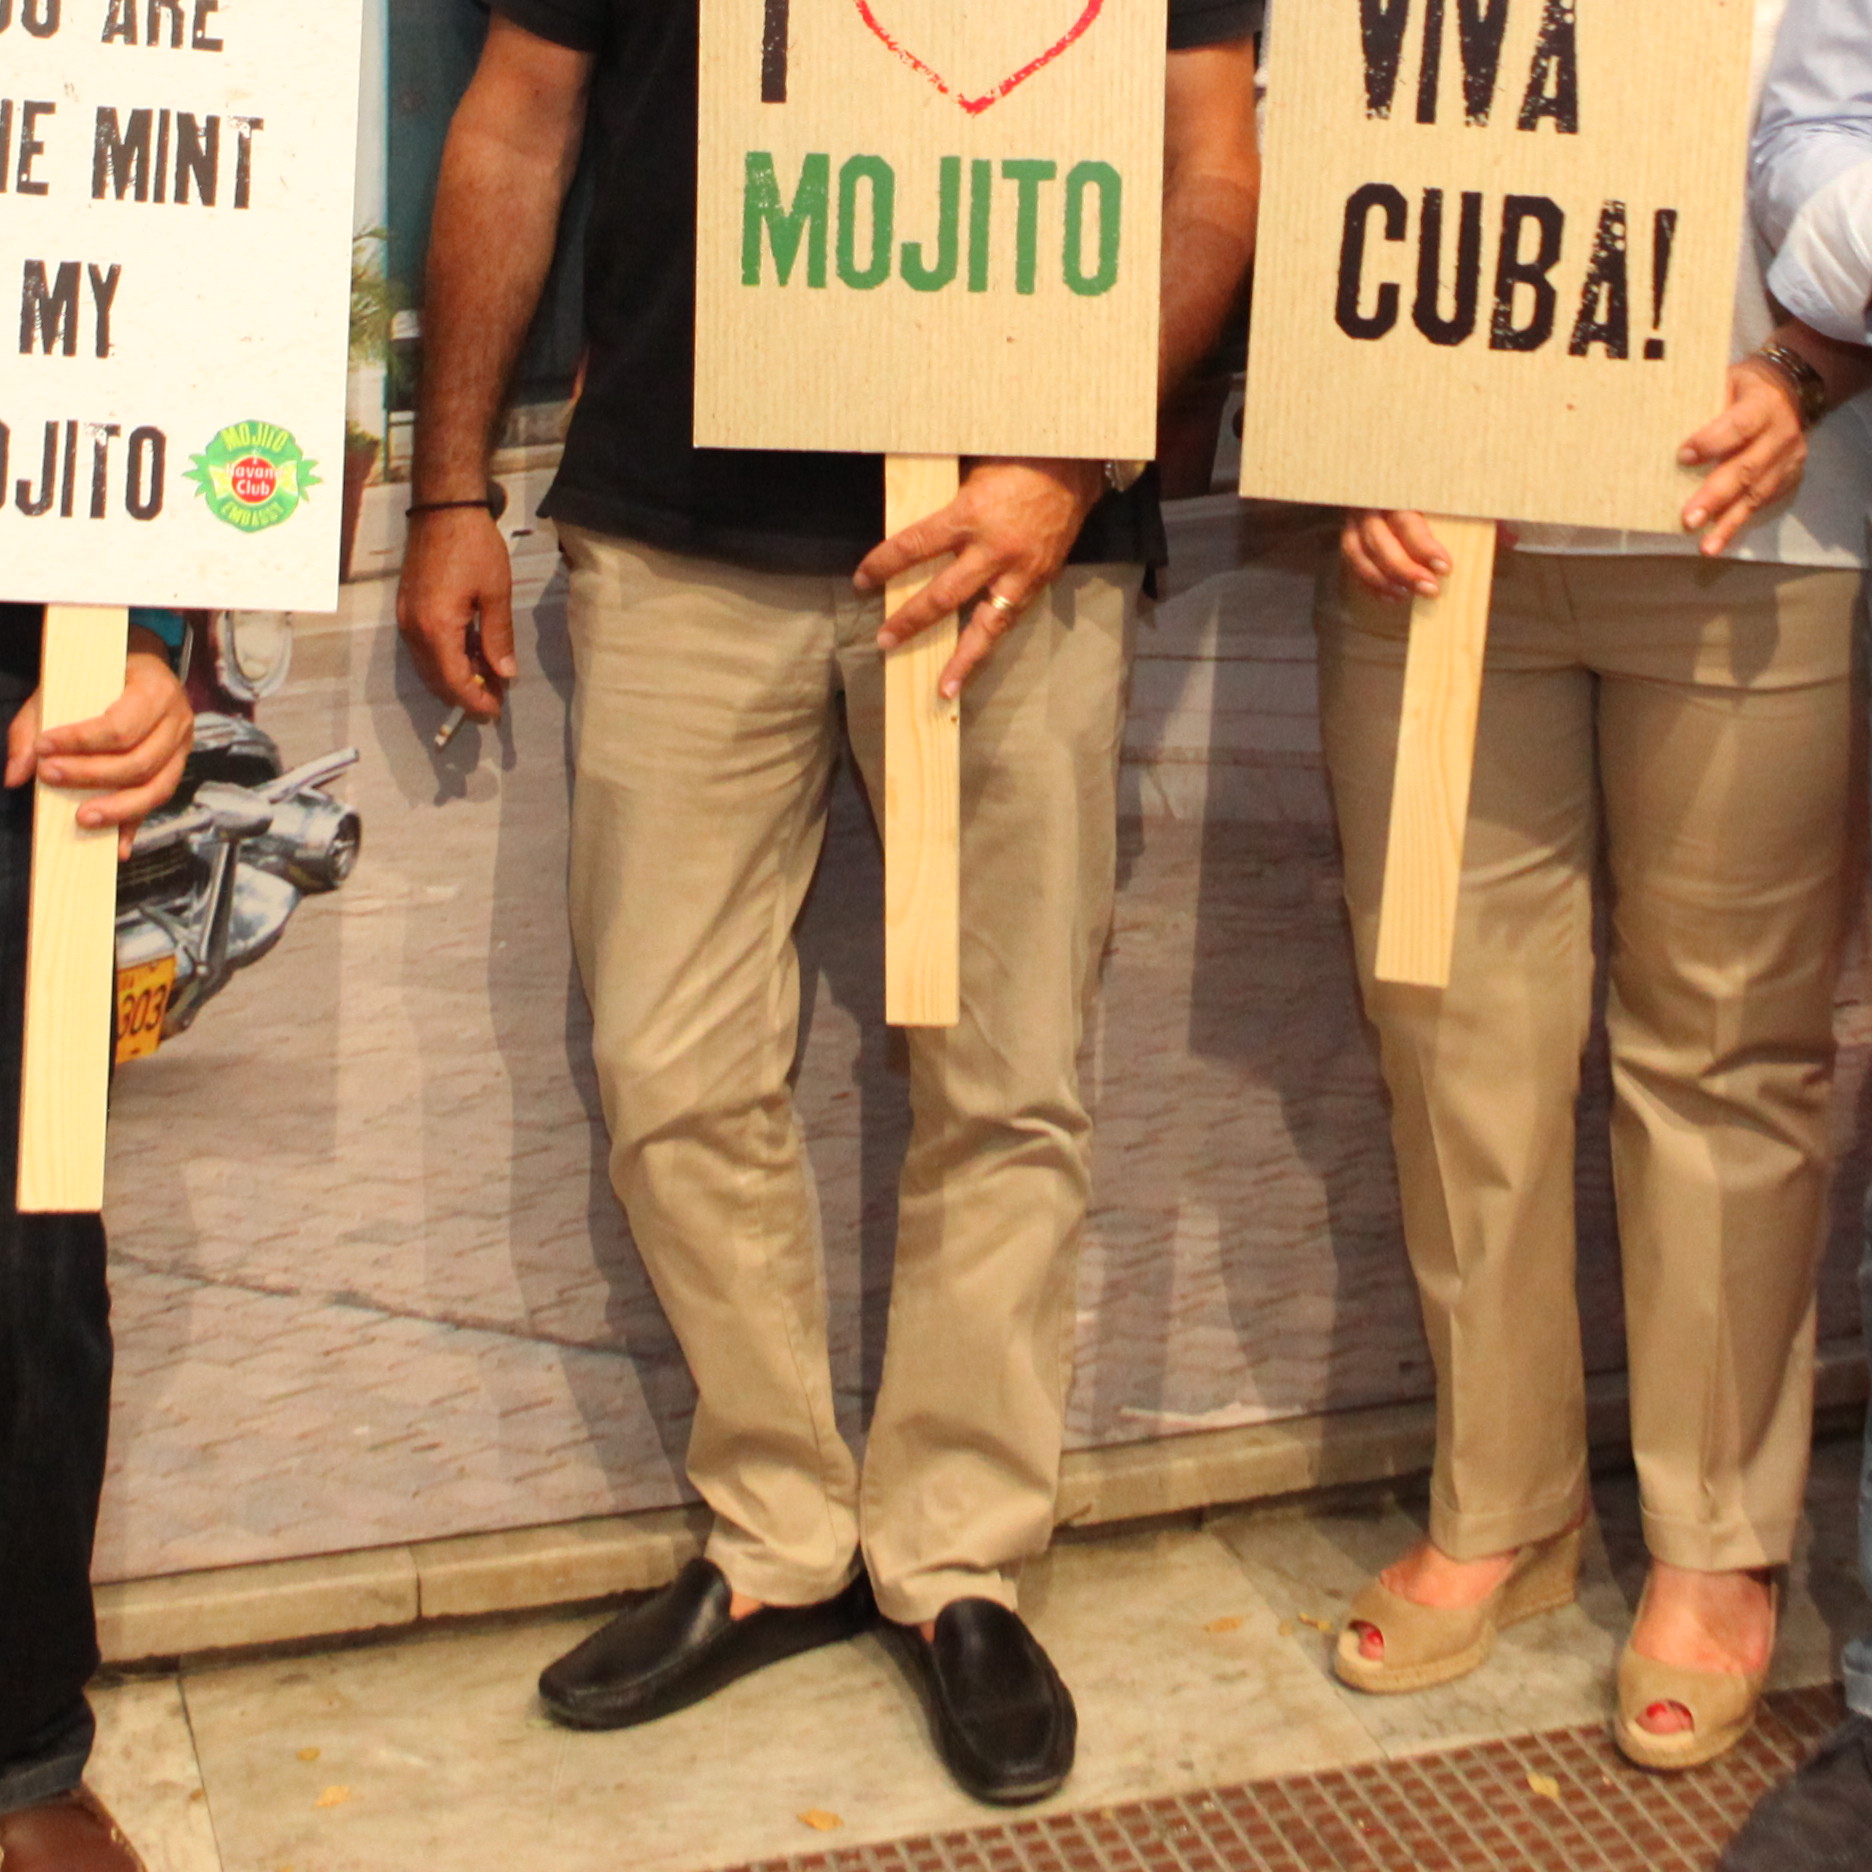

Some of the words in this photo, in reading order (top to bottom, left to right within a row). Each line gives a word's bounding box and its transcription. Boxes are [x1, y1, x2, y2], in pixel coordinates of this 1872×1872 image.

[91, 105, 265, 210] MINT
[740, 150, 1123, 298] MOJITO
[1333, 181, 1678, 362] CUBA!
[17, 258, 122, 360] MY
[220, 422, 289, 452] MOJITO
[236, 479, 271, 497] Club
